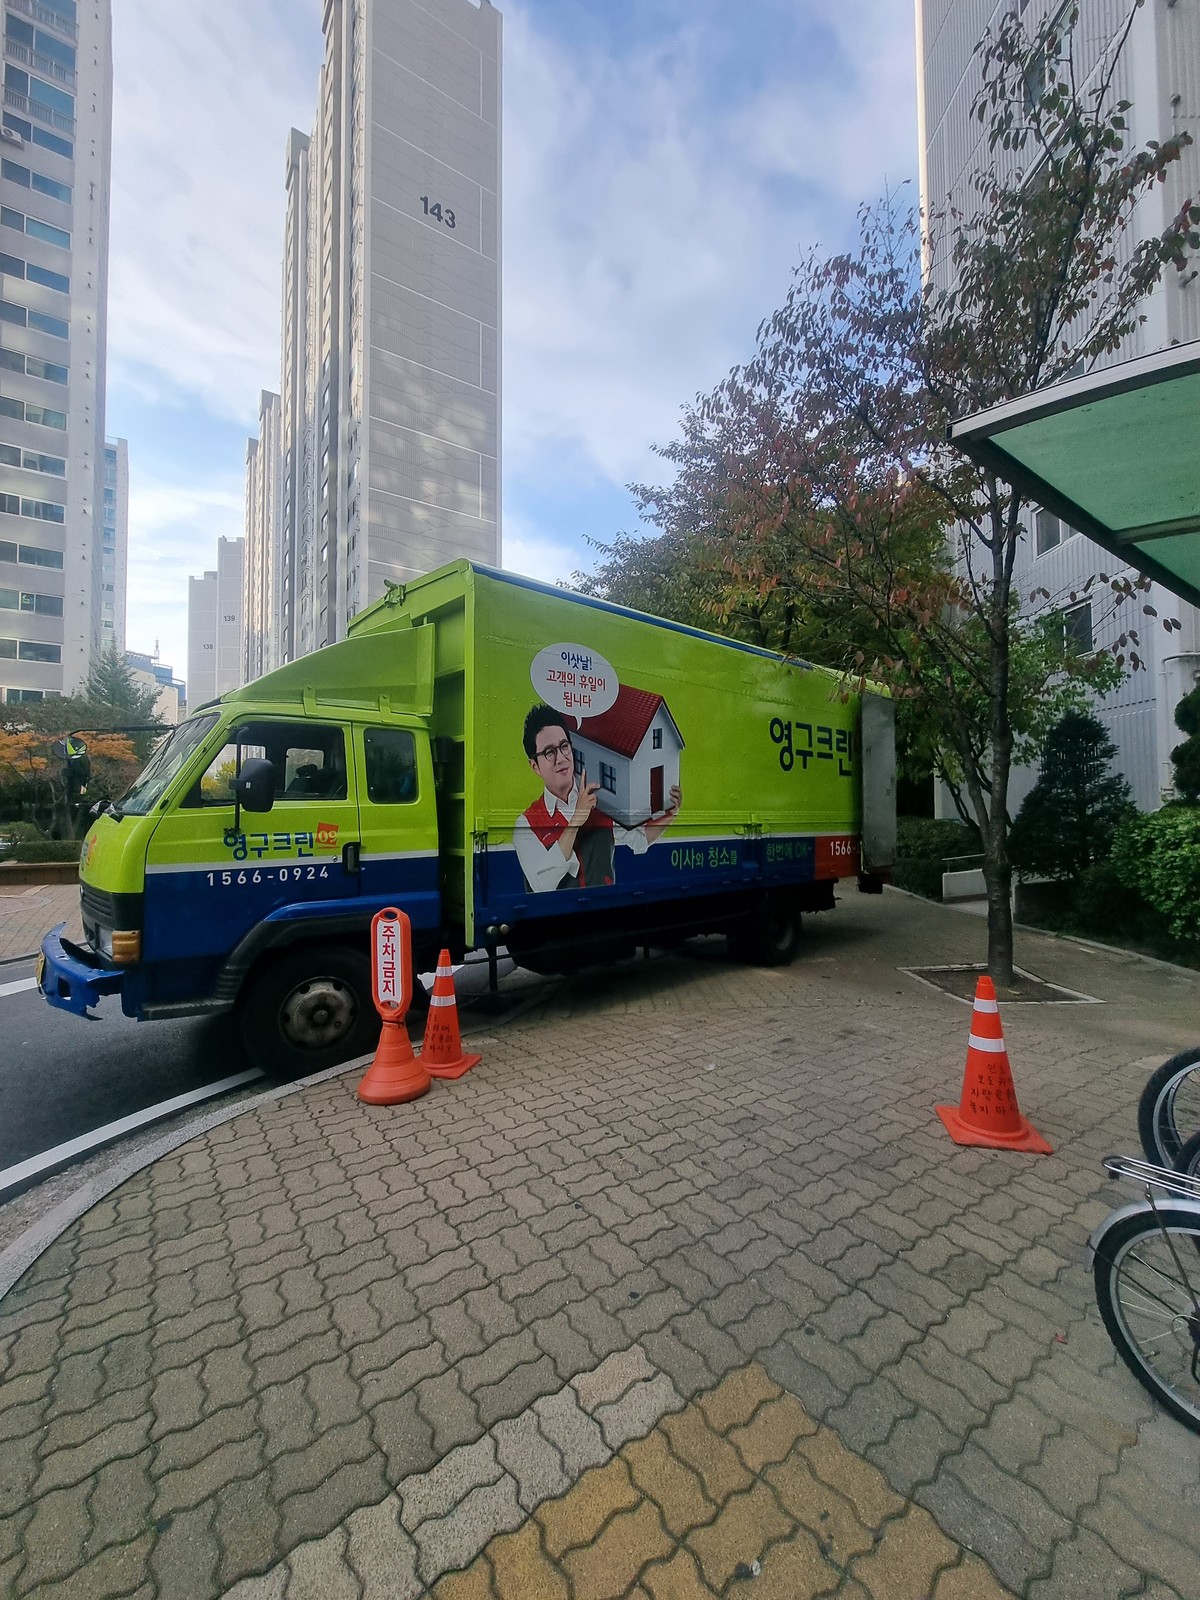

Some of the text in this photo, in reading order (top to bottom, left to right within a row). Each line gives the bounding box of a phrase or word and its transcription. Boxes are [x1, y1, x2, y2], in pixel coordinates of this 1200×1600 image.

[420, 196, 455, 229] 143
[561, 651, 592, 671] 이삿날!
[546, 669, 606, 692] 고객의 휴일이
[563, 691, 592, 708] 됩니다
[769, 717, 853, 776] 영구크린
[223, 830, 314, 861] 영구크린
[671, 848, 704, 870] 이사와
[707, 846, 738, 868] 청소를
[207, 866, 329, 887] 1566-0924
[382, 925, 396, 996] 주차금지
